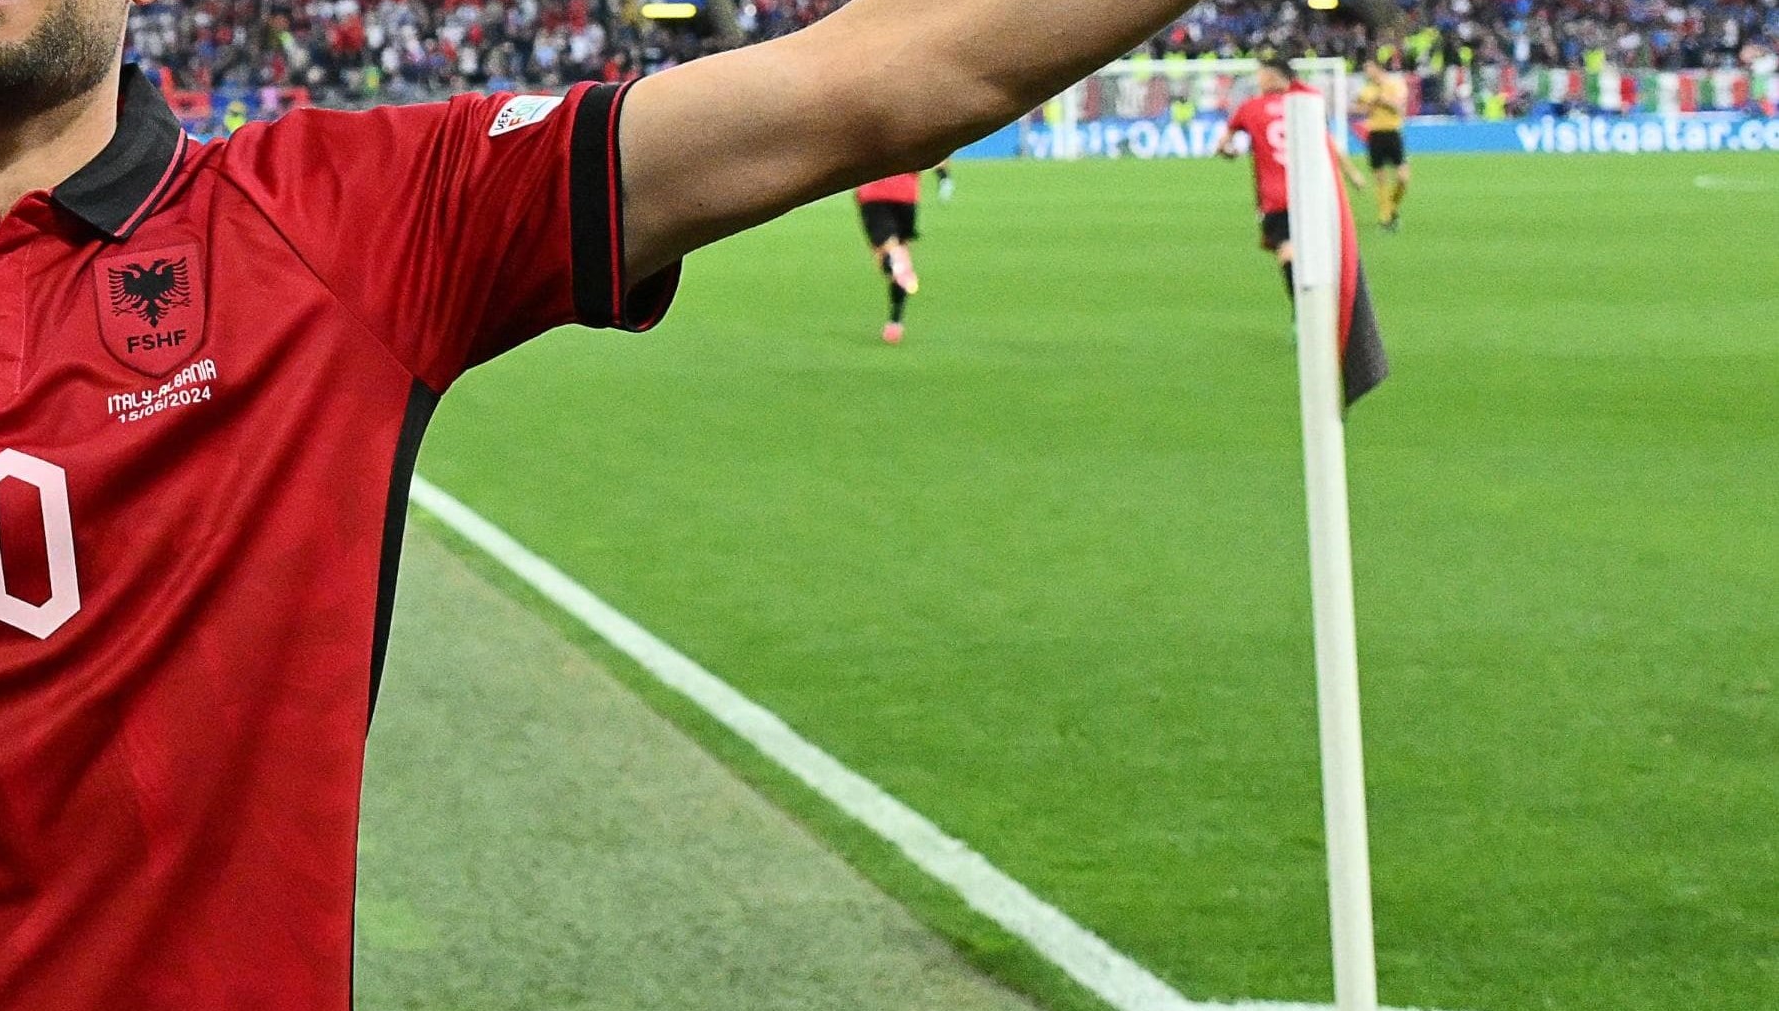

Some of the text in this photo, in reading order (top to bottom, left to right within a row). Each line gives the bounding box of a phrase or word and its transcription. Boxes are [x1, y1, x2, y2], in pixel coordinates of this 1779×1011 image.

[126, 330, 187, 354] FSHF
[107, 358, 217, 415] ITALY-ALBANIA
[117, 385, 212, 424] 15/06/2024
